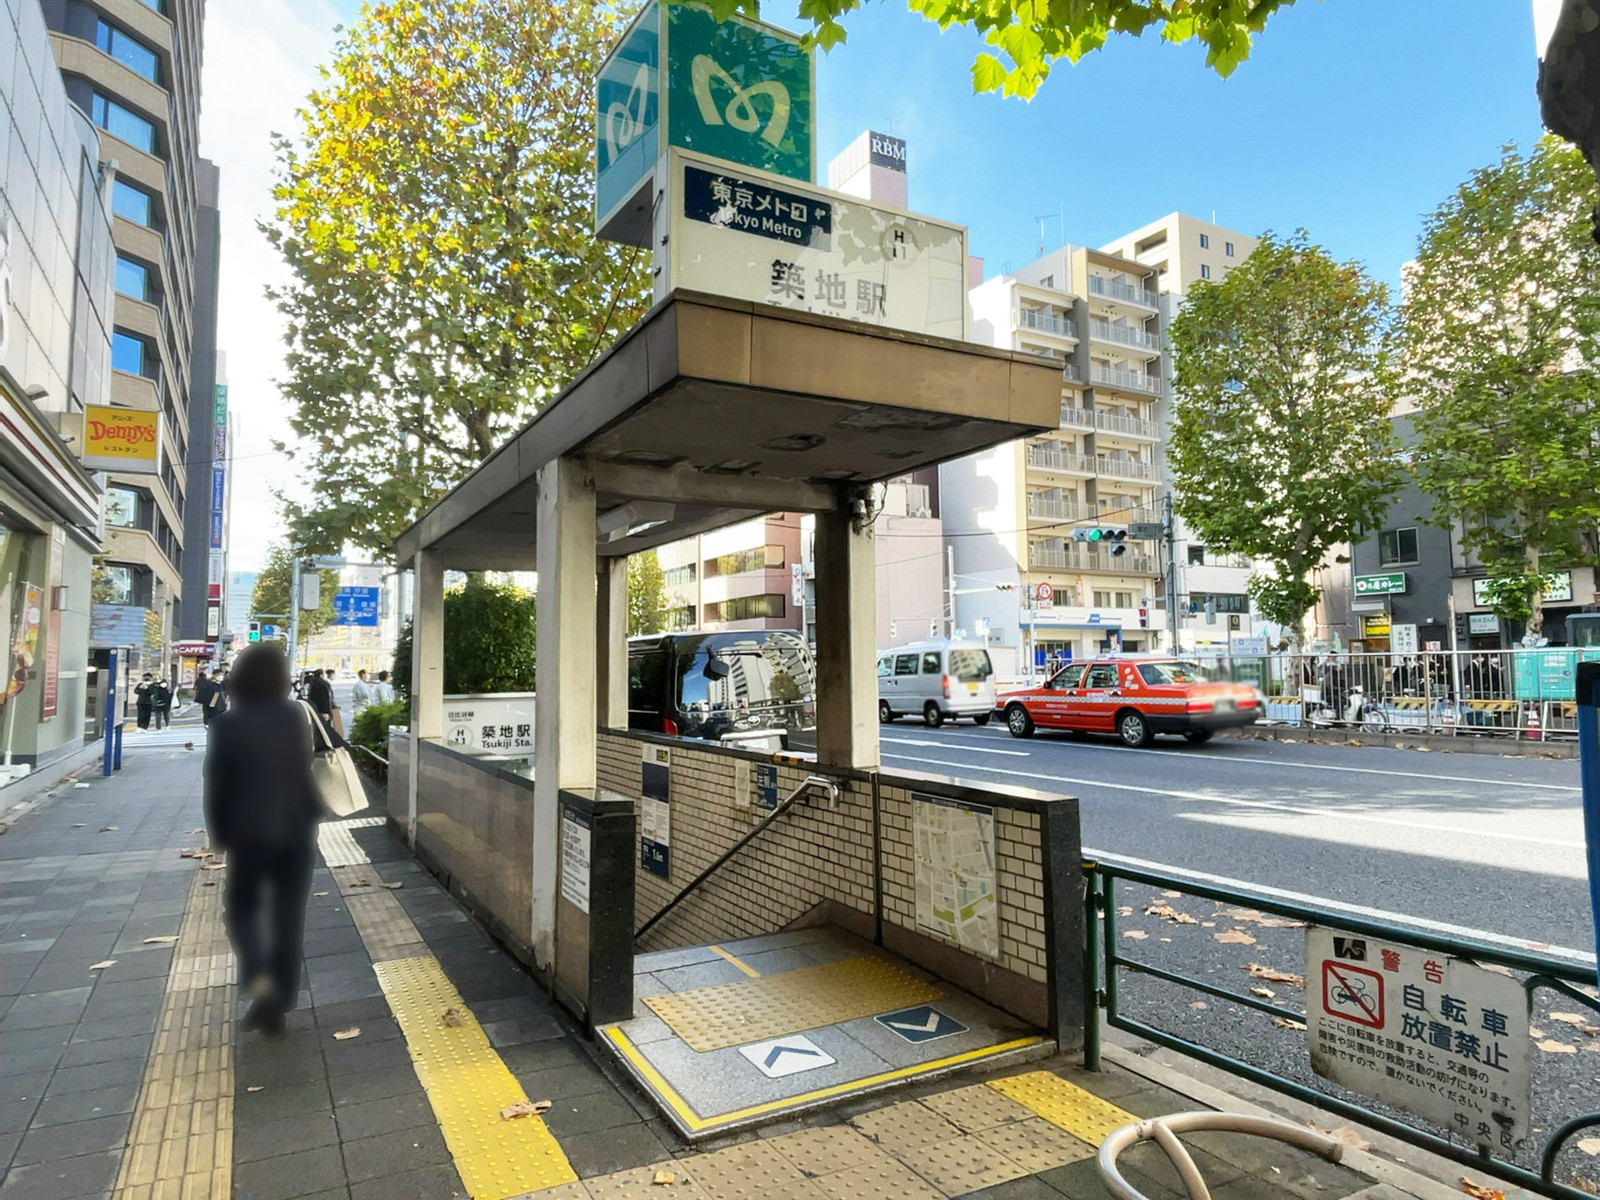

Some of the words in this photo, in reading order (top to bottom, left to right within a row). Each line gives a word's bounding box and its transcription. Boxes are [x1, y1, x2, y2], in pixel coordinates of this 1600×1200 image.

[871, 137, 906, 161] RBM
[712, 182, 808, 223] 東京メトロ
[762, 217, 802, 239] Metro
[894, 230, 904, 243] H
[771, 259, 887, 317] 築地駅
[88, 421, 156, 444] Denny's
[482, 724, 530, 739] 築地駅
[482, 740, 512, 749] Tsukiji
[515, 739, 532, 747] Sta.
[1381, 949, 1444, 984] 警告
[1403, 984, 1509, 1037] 自転車
[1401, 1012, 1510, 1073] 放置禁止
[1454, 1112, 1514, 1150] 中央区
